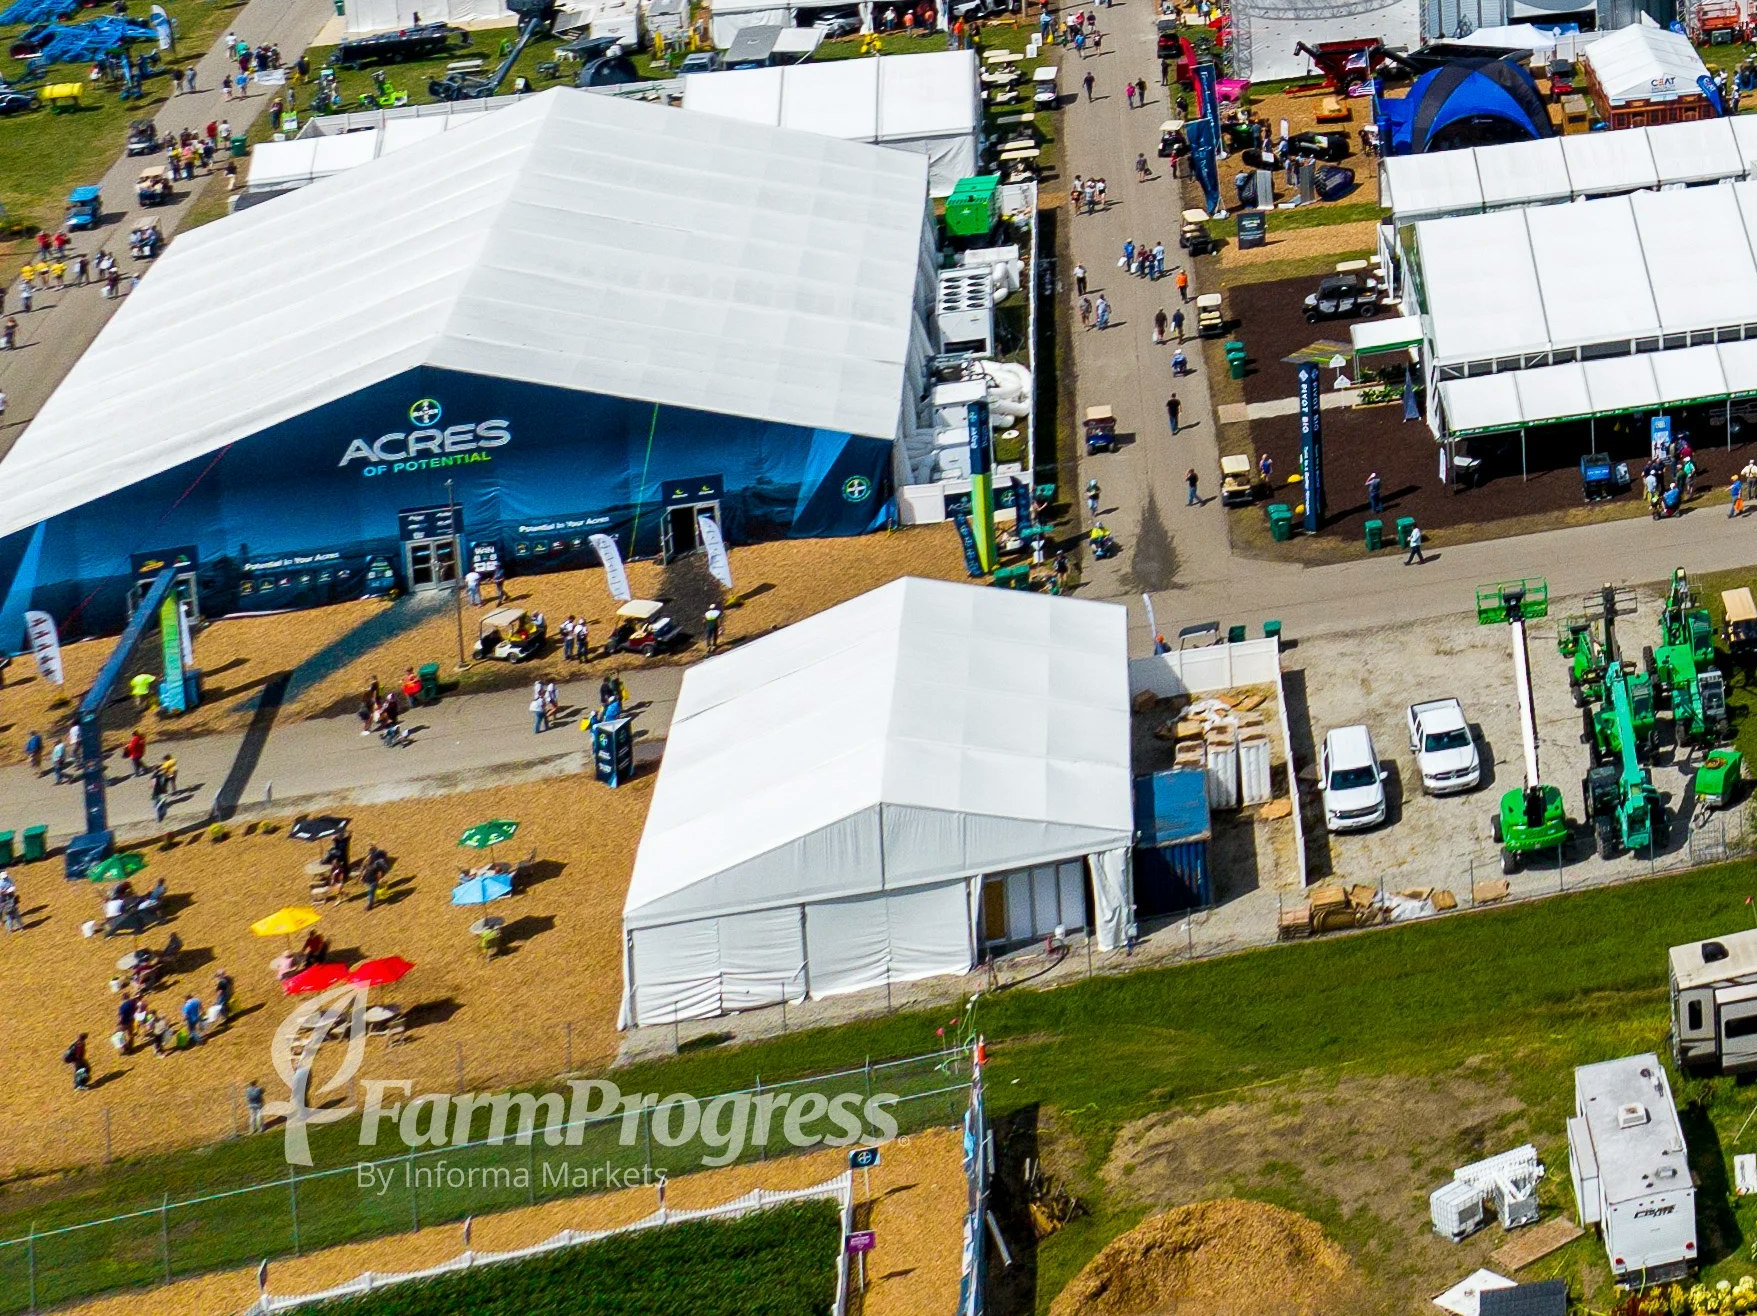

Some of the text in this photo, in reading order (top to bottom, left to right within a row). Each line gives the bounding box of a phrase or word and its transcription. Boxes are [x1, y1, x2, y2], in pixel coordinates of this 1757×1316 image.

[1650, 76, 1676, 87] CEAT
[1301, 384, 1310, 434] PIVOT BIO
[338, 419, 511, 467] ACRES
[363, 451, 491, 477] OF POTENTIAL
[518, 523, 558, 533] Potential
[568, 519, 585, 527] Your
[586, 515, 610, 525] Acres
[244, 561, 282, 571] Potential
[294, 557, 313, 565] Your
[315, 552, 341, 562] Acres
